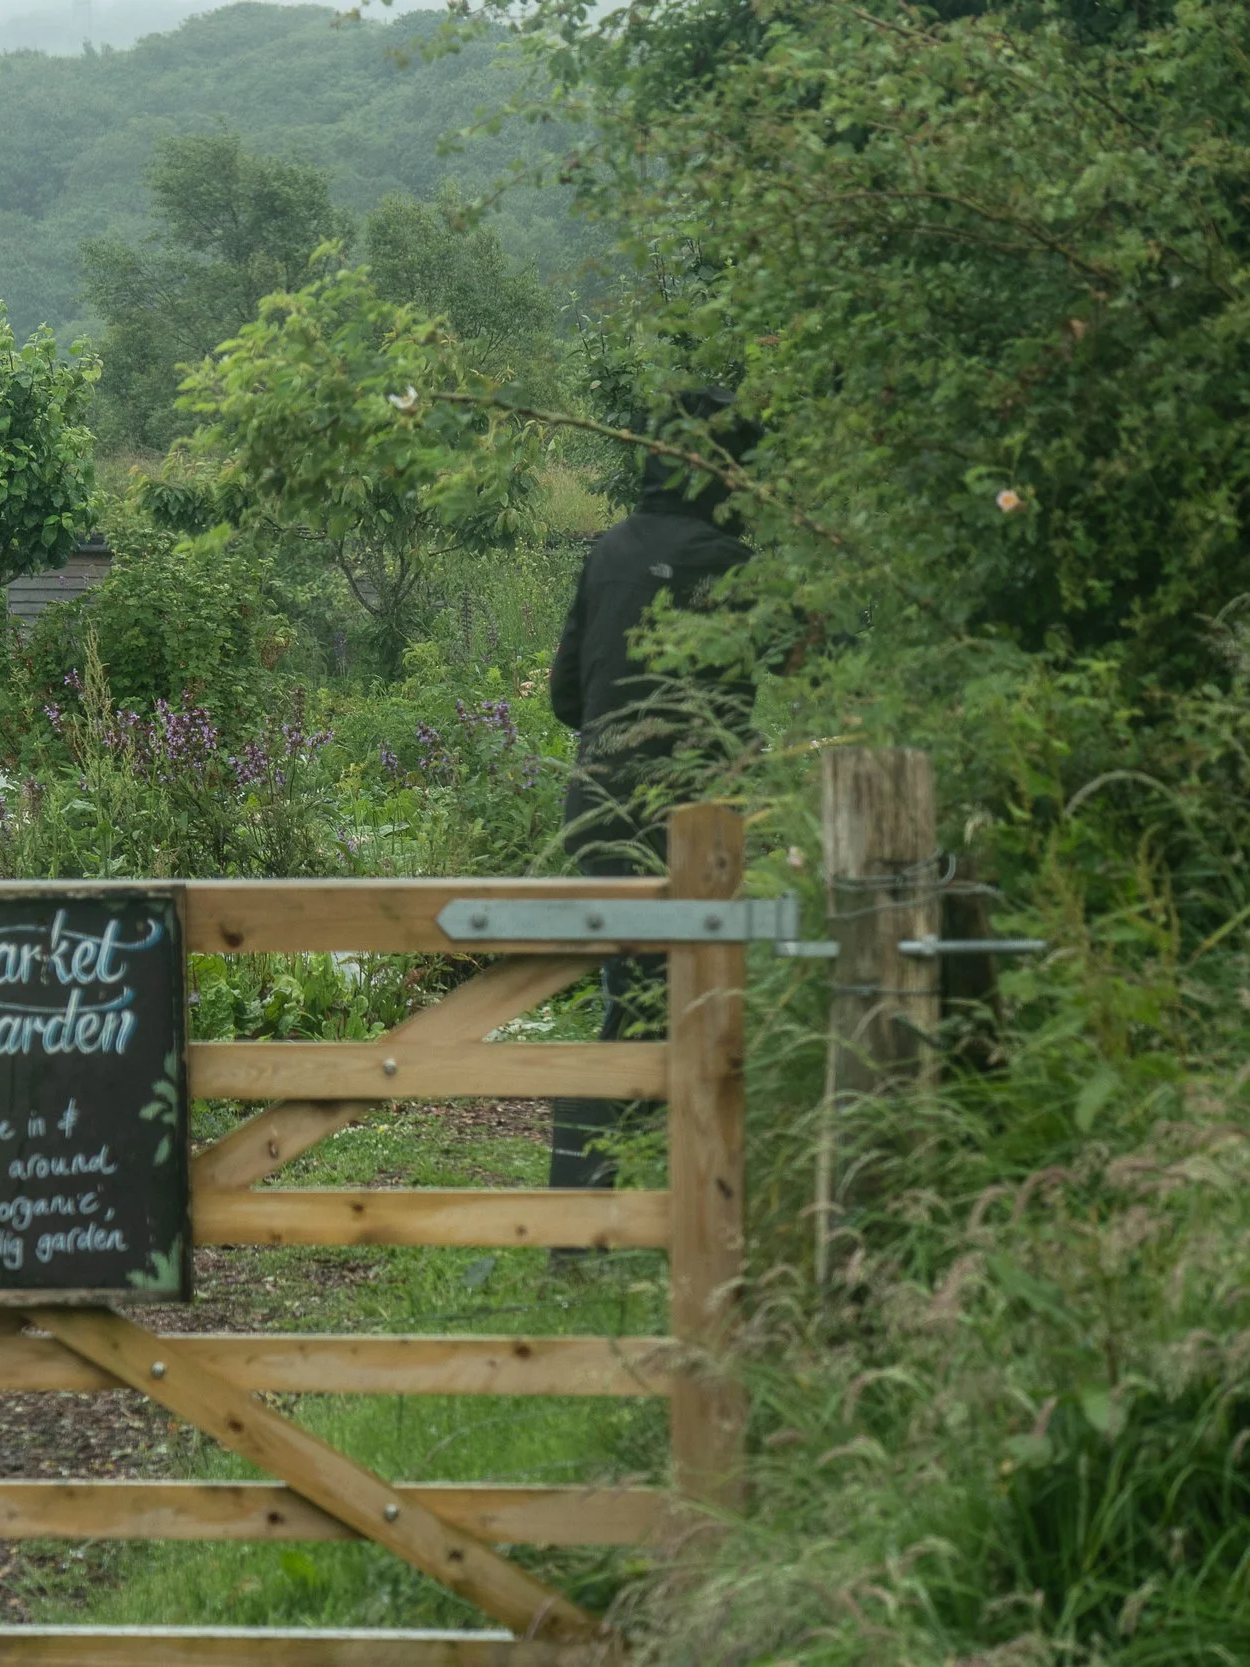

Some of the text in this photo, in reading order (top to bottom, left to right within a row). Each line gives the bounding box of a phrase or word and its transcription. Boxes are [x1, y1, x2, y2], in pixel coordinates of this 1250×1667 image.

[28, 1109, 46, 1137] in
[8, 1145, 118, 1181] around
[35, 1222, 129, 1264] garden
